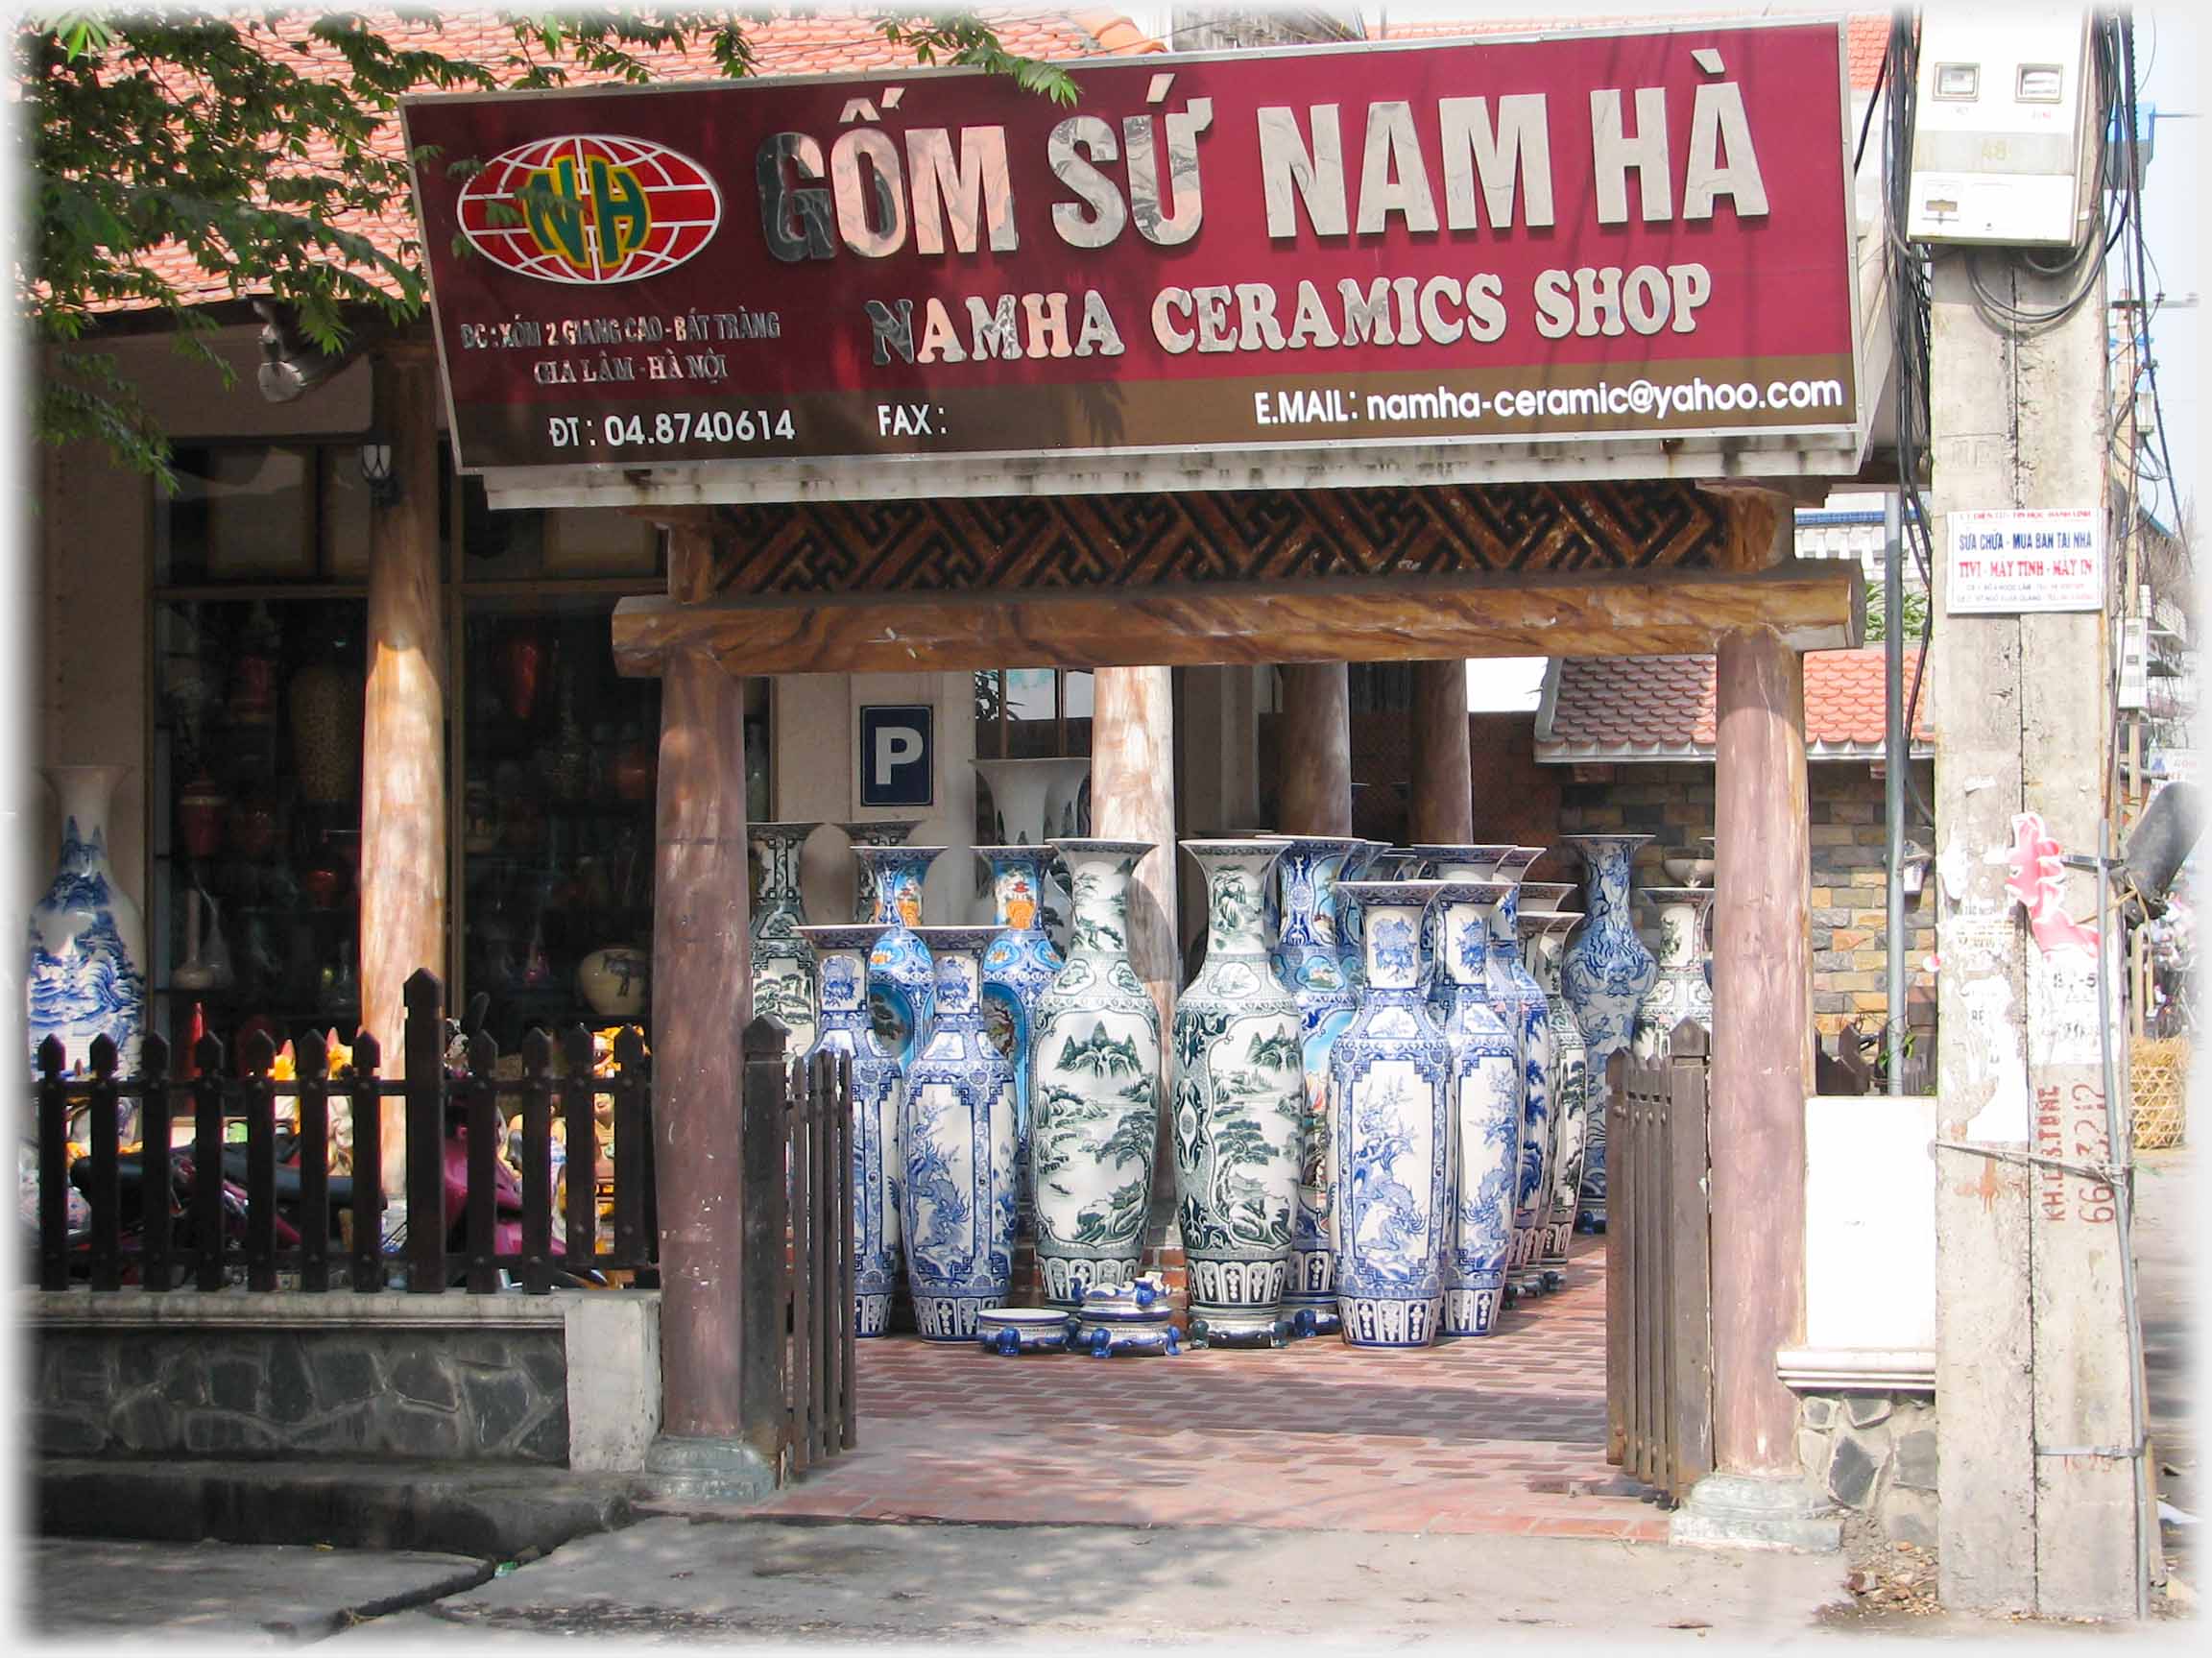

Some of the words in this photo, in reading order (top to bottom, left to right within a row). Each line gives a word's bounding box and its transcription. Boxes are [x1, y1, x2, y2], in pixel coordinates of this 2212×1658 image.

[755, 87, 1020, 262] GỐM
[1046, 74, 1214, 249] SỨ
[1257, 93, 1555, 239] NAM
[1590, 48, 1769, 225] HÀ
[562, 318, 622, 346] GIANG
[865, 290, 1125, 366] NAMHA
[1151, 273, 1508, 353] CERAMICS
[1534, 263, 1712, 340] SHOP
[1365, 376, 1843, 421] namha-ceramic@yahoo.com
[603, 408, 796, 446] 04.8740614
[875, 726, 924, 785] P
